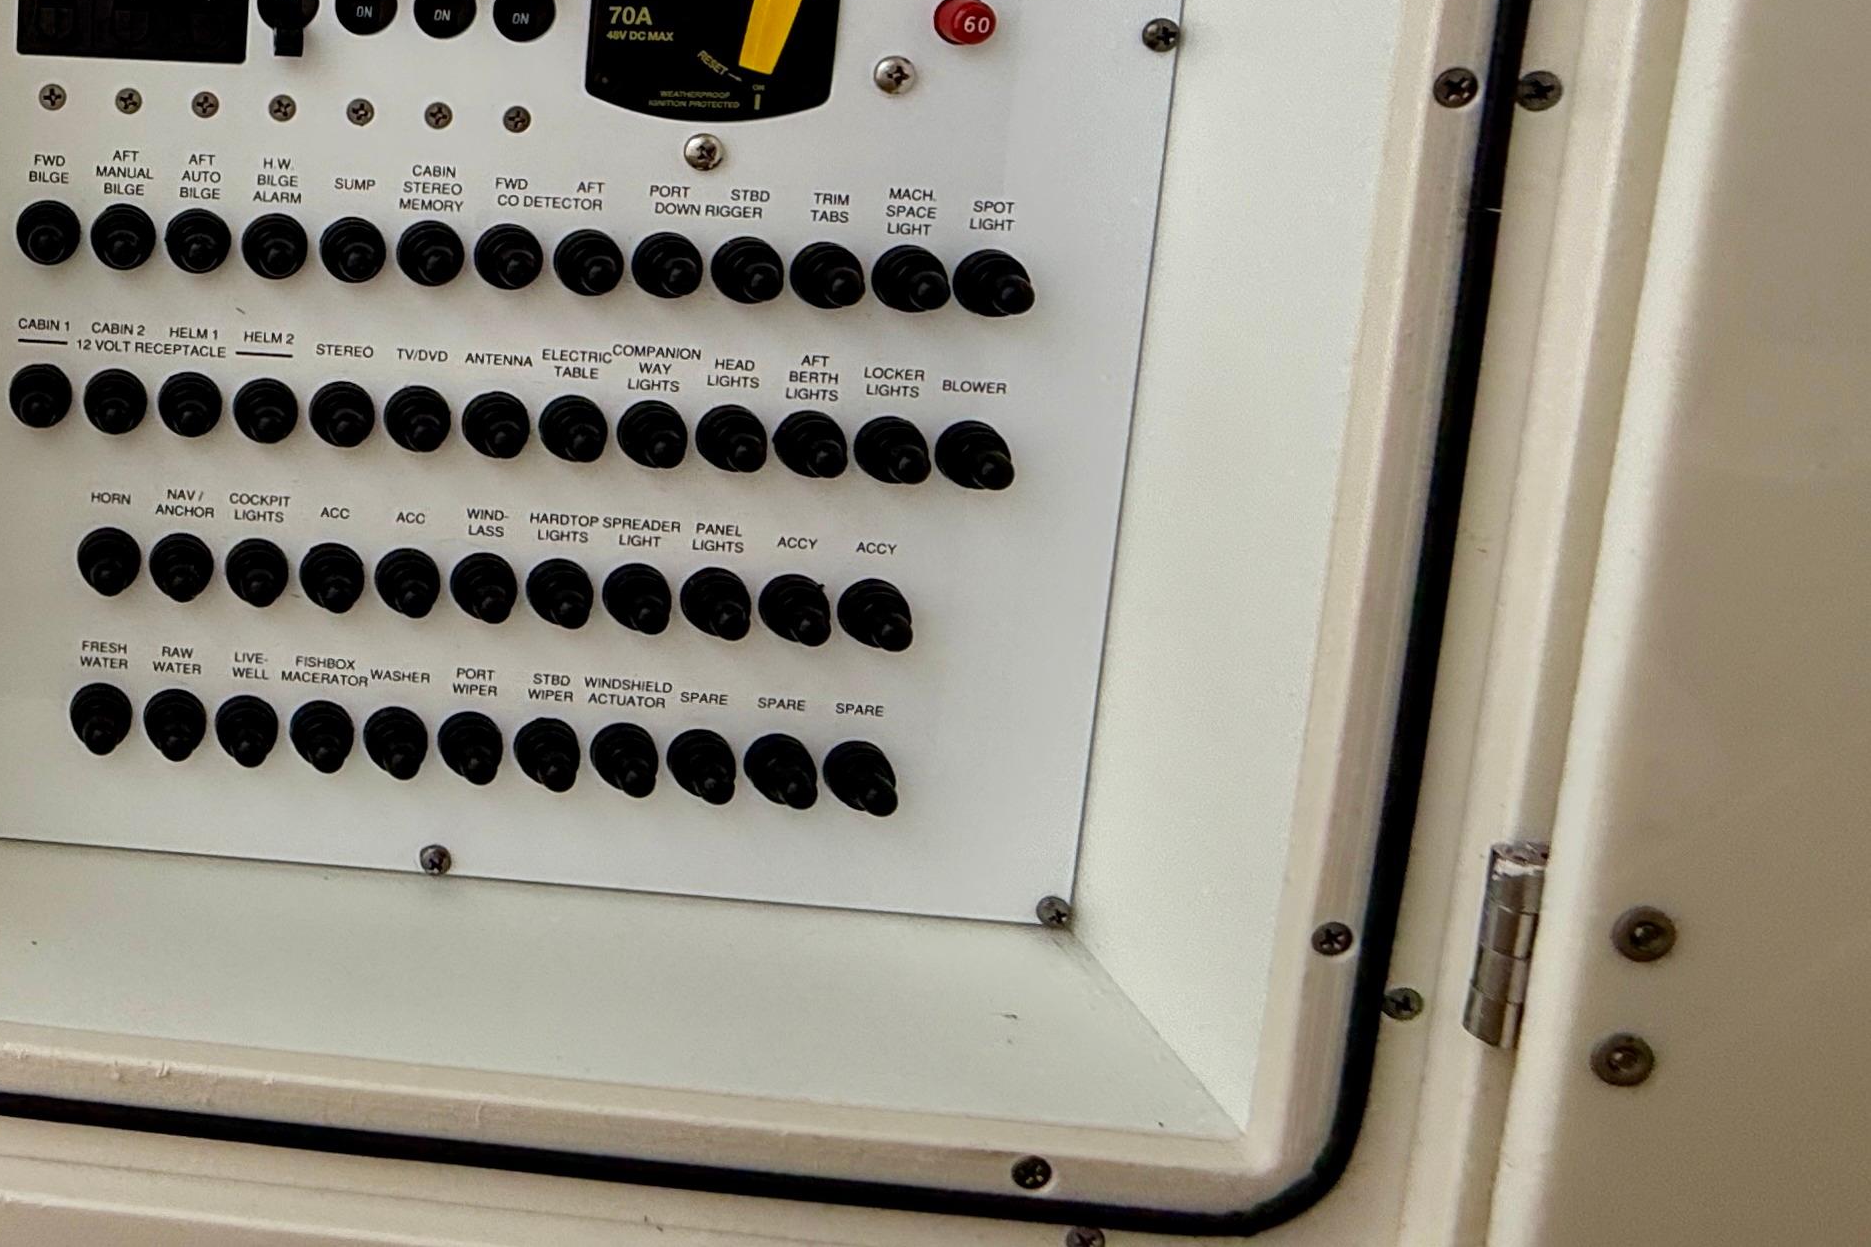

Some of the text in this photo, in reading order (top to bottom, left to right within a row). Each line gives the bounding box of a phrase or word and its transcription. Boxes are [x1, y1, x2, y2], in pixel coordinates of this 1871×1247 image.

[356, 6, 373, 18] ON
[609, 7, 652, 26] 70A
[963, 16, 990, 33] 60
[607, 31, 673, 41] 48V DC MAX
[698, 50, 728, 75] RESET
[34, 155, 65, 167] FWD
[113, 150, 139, 162] AFT
[29, 171, 69, 184] BILGE
[96, 166, 153, 179] MANUAL
[182, 170, 221, 184] AUTO
[412, 165, 456, 178] CABIN
[257, 174, 298, 187] BILGE
[334, 178, 375, 191] SUMP
[496, 178, 604, 193] FWD AFT
[403, 182, 462, 195] STEREO
[650, 185, 770, 203] PORT STBD
[253, 191, 301, 204] ALARM
[498, 195, 602, 210] CO DETECTOR
[814, 193, 849, 206] TRIM
[399, 198, 463, 212] MEMORY
[655, 202, 762, 219] DOWN RIGGER
[973, 201, 1014, 214] SPOT
[811, 210, 849, 223] TABS
[886, 206, 936, 219] SPACE
[887, 223, 931, 236] LIGHT
[76, 339, 226, 358] 12 VOLT RECEPTACLE
[316, 343, 373, 358] STEREO
[397, 348, 448, 362] TV/DVD
[612, 344, 701, 360] COMPANION
[465, 353, 533, 367] ANTENNA
[542, 349, 612, 364] ELECTRIC
[801, 355, 829, 367] AFT
[639, 362, 672, 375] WAY
[715, 358, 755, 372] HEAD
[554, 366, 599, 379] TABLE
[789, 371, 839, 384] BERTH
[864, 367, 924, 382] LOCKER
[628, 378, 680, 393] LIGHTS
[942, 379, 1006, 395] BLOWER
[786, 387, 838, 402] LIGHTS
[91, 492, 131, 504] HORN
[230, 493, 290, 507] COCKPIT
[155, 505, 214, 519] ANCHOR
[234, 509, 284, 523] LIGHTS
[321, 507, 350, 519] ACC
[530, 513, 599, 529] HARDTOP
[603, 517, 680, 533] SPREADER
[468, 524, 504, 537] LASS
[696, 523, 742, 536] PANEL
[619, 534, 661, 548] LIGHT
[692, 539, 744, 553] LIGHTS
[777, 537, 817, 550] ACCY
[82, 641, 127, 654] FRESH
[162, 646, 193, 659] RAW
[153, 661, 202, 675] WATER
[296, 656, 355, 670] FISHBOX
[233, 667, 269, 680] WELL
[282, 671, 368, 687] MACERATOR
[371, 669, 430, 683] WASHER
[456, 667, 495, 681] PORT
[533, 673, 571, 687] STBD
[453, 683, 497, 697] WIPER
[584, 677, 672, 694] WINDSHIELD
[588, 693, 665, 709] ACTUATOR
[681, 691, 728, 706] SPARE
